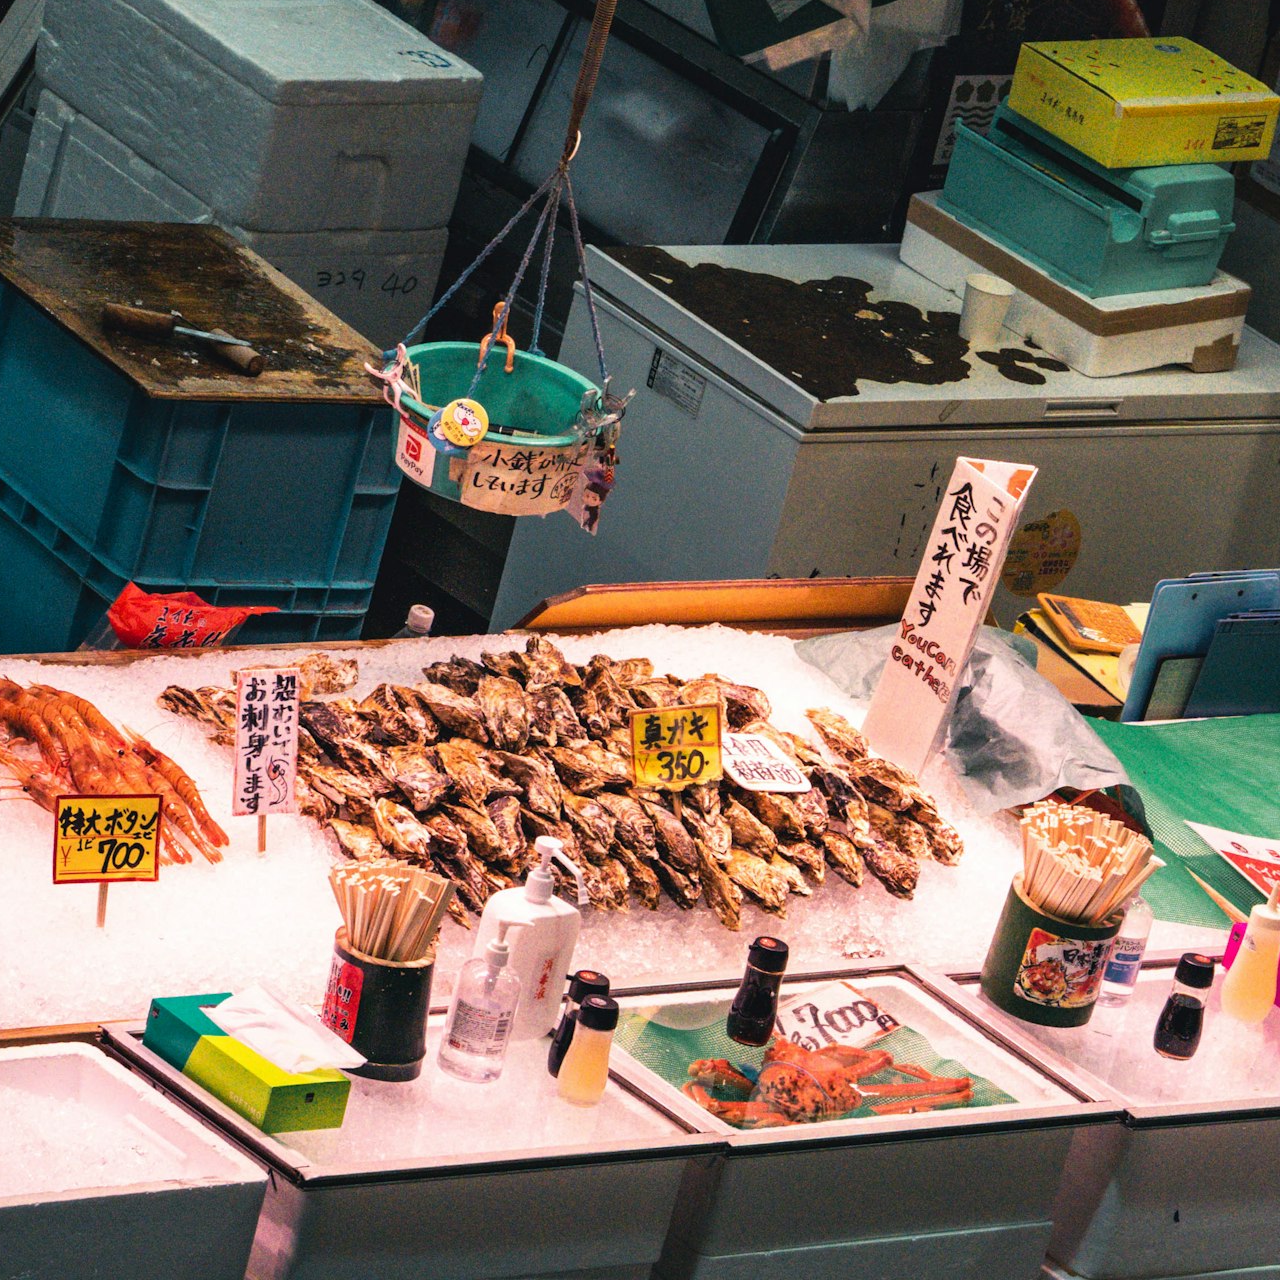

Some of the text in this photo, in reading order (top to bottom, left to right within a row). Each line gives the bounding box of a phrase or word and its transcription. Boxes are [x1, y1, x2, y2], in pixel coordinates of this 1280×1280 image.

[400, 452, 425, 476] PayPay
[918, 481, 978, 628] 食べれます
[959, 495, 1008, 606] この場で
[239, 675, 269, 815] お刺身します
[639, 711, 710, 751] 真ガキ
[59, 805, 158, 837] 特大ボタン
